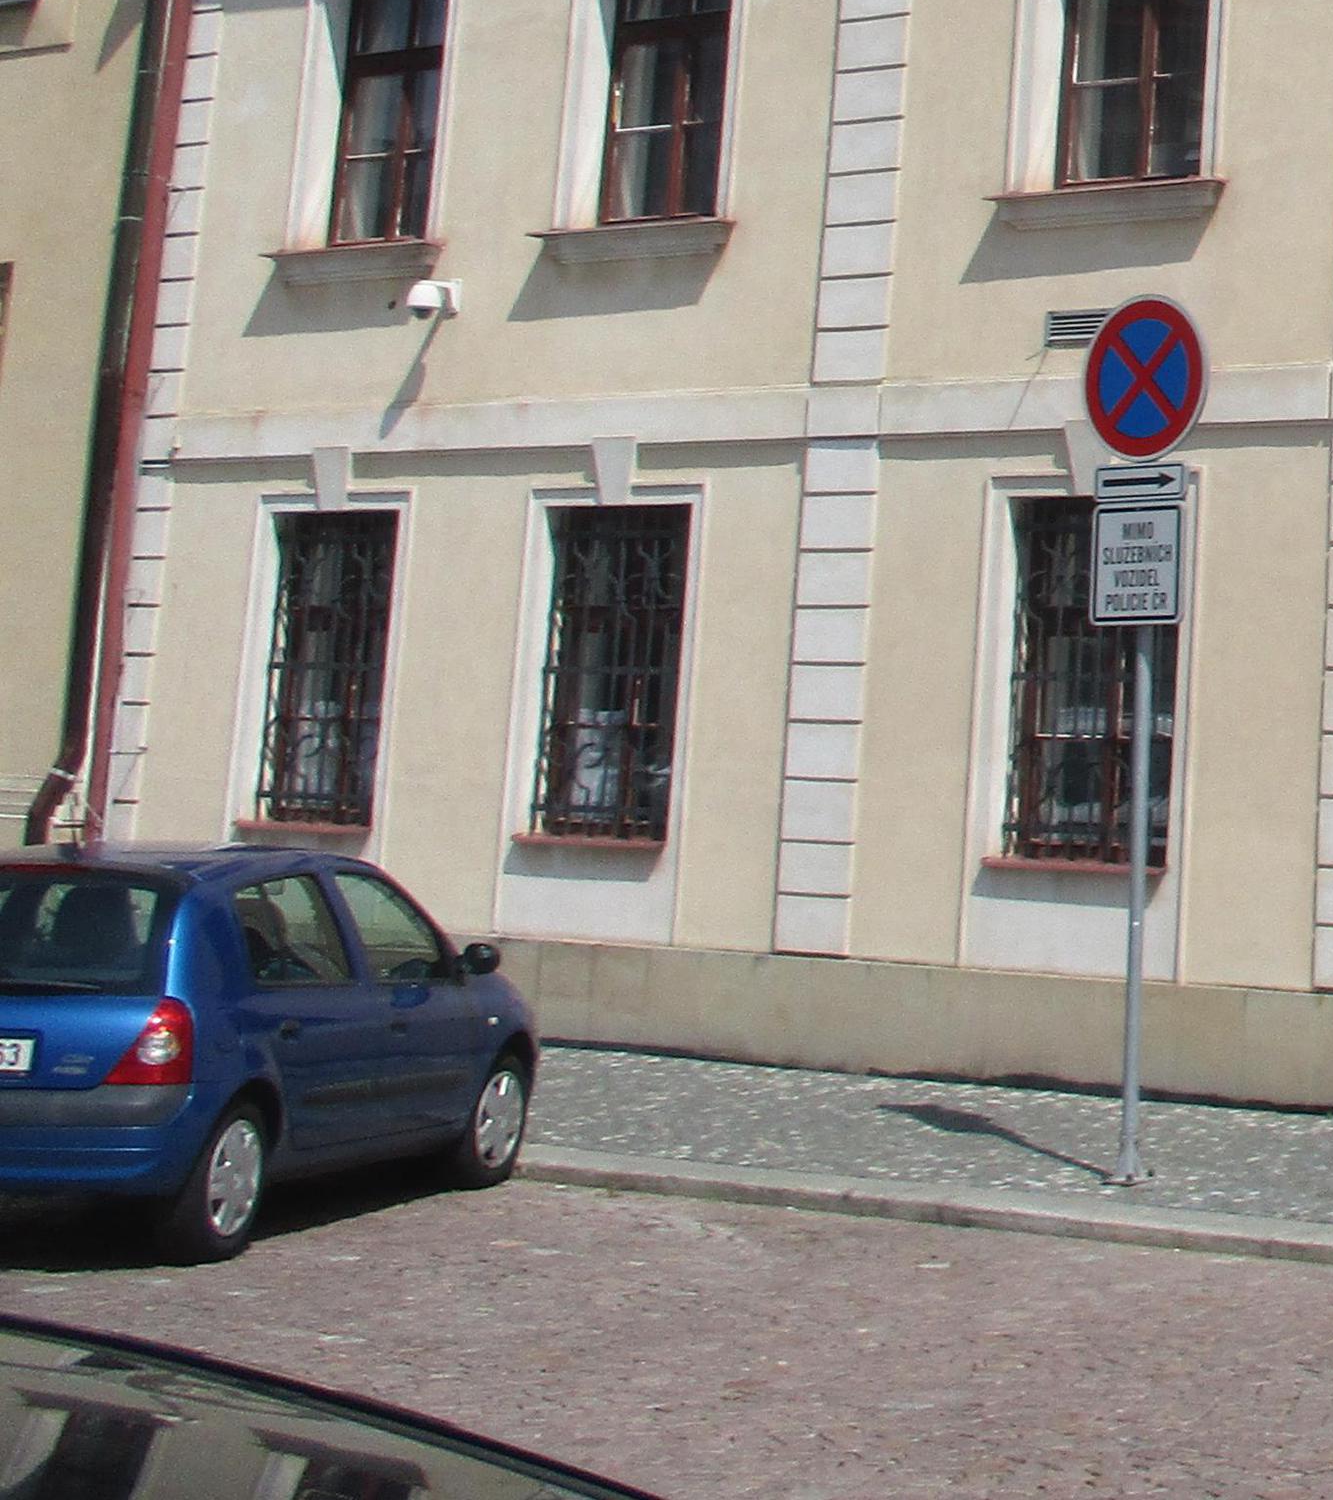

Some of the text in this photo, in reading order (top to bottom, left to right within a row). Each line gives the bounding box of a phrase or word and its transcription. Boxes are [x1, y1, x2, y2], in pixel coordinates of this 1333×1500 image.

[1122, 521, 1154, 540] MIMO
[1103, 541, 1173, 565] SLUŽEBNÍCH
[1114, 569, 1160, 587] VOZIDEL
[1105, 588, 1168, 612] POLICIE ČR
